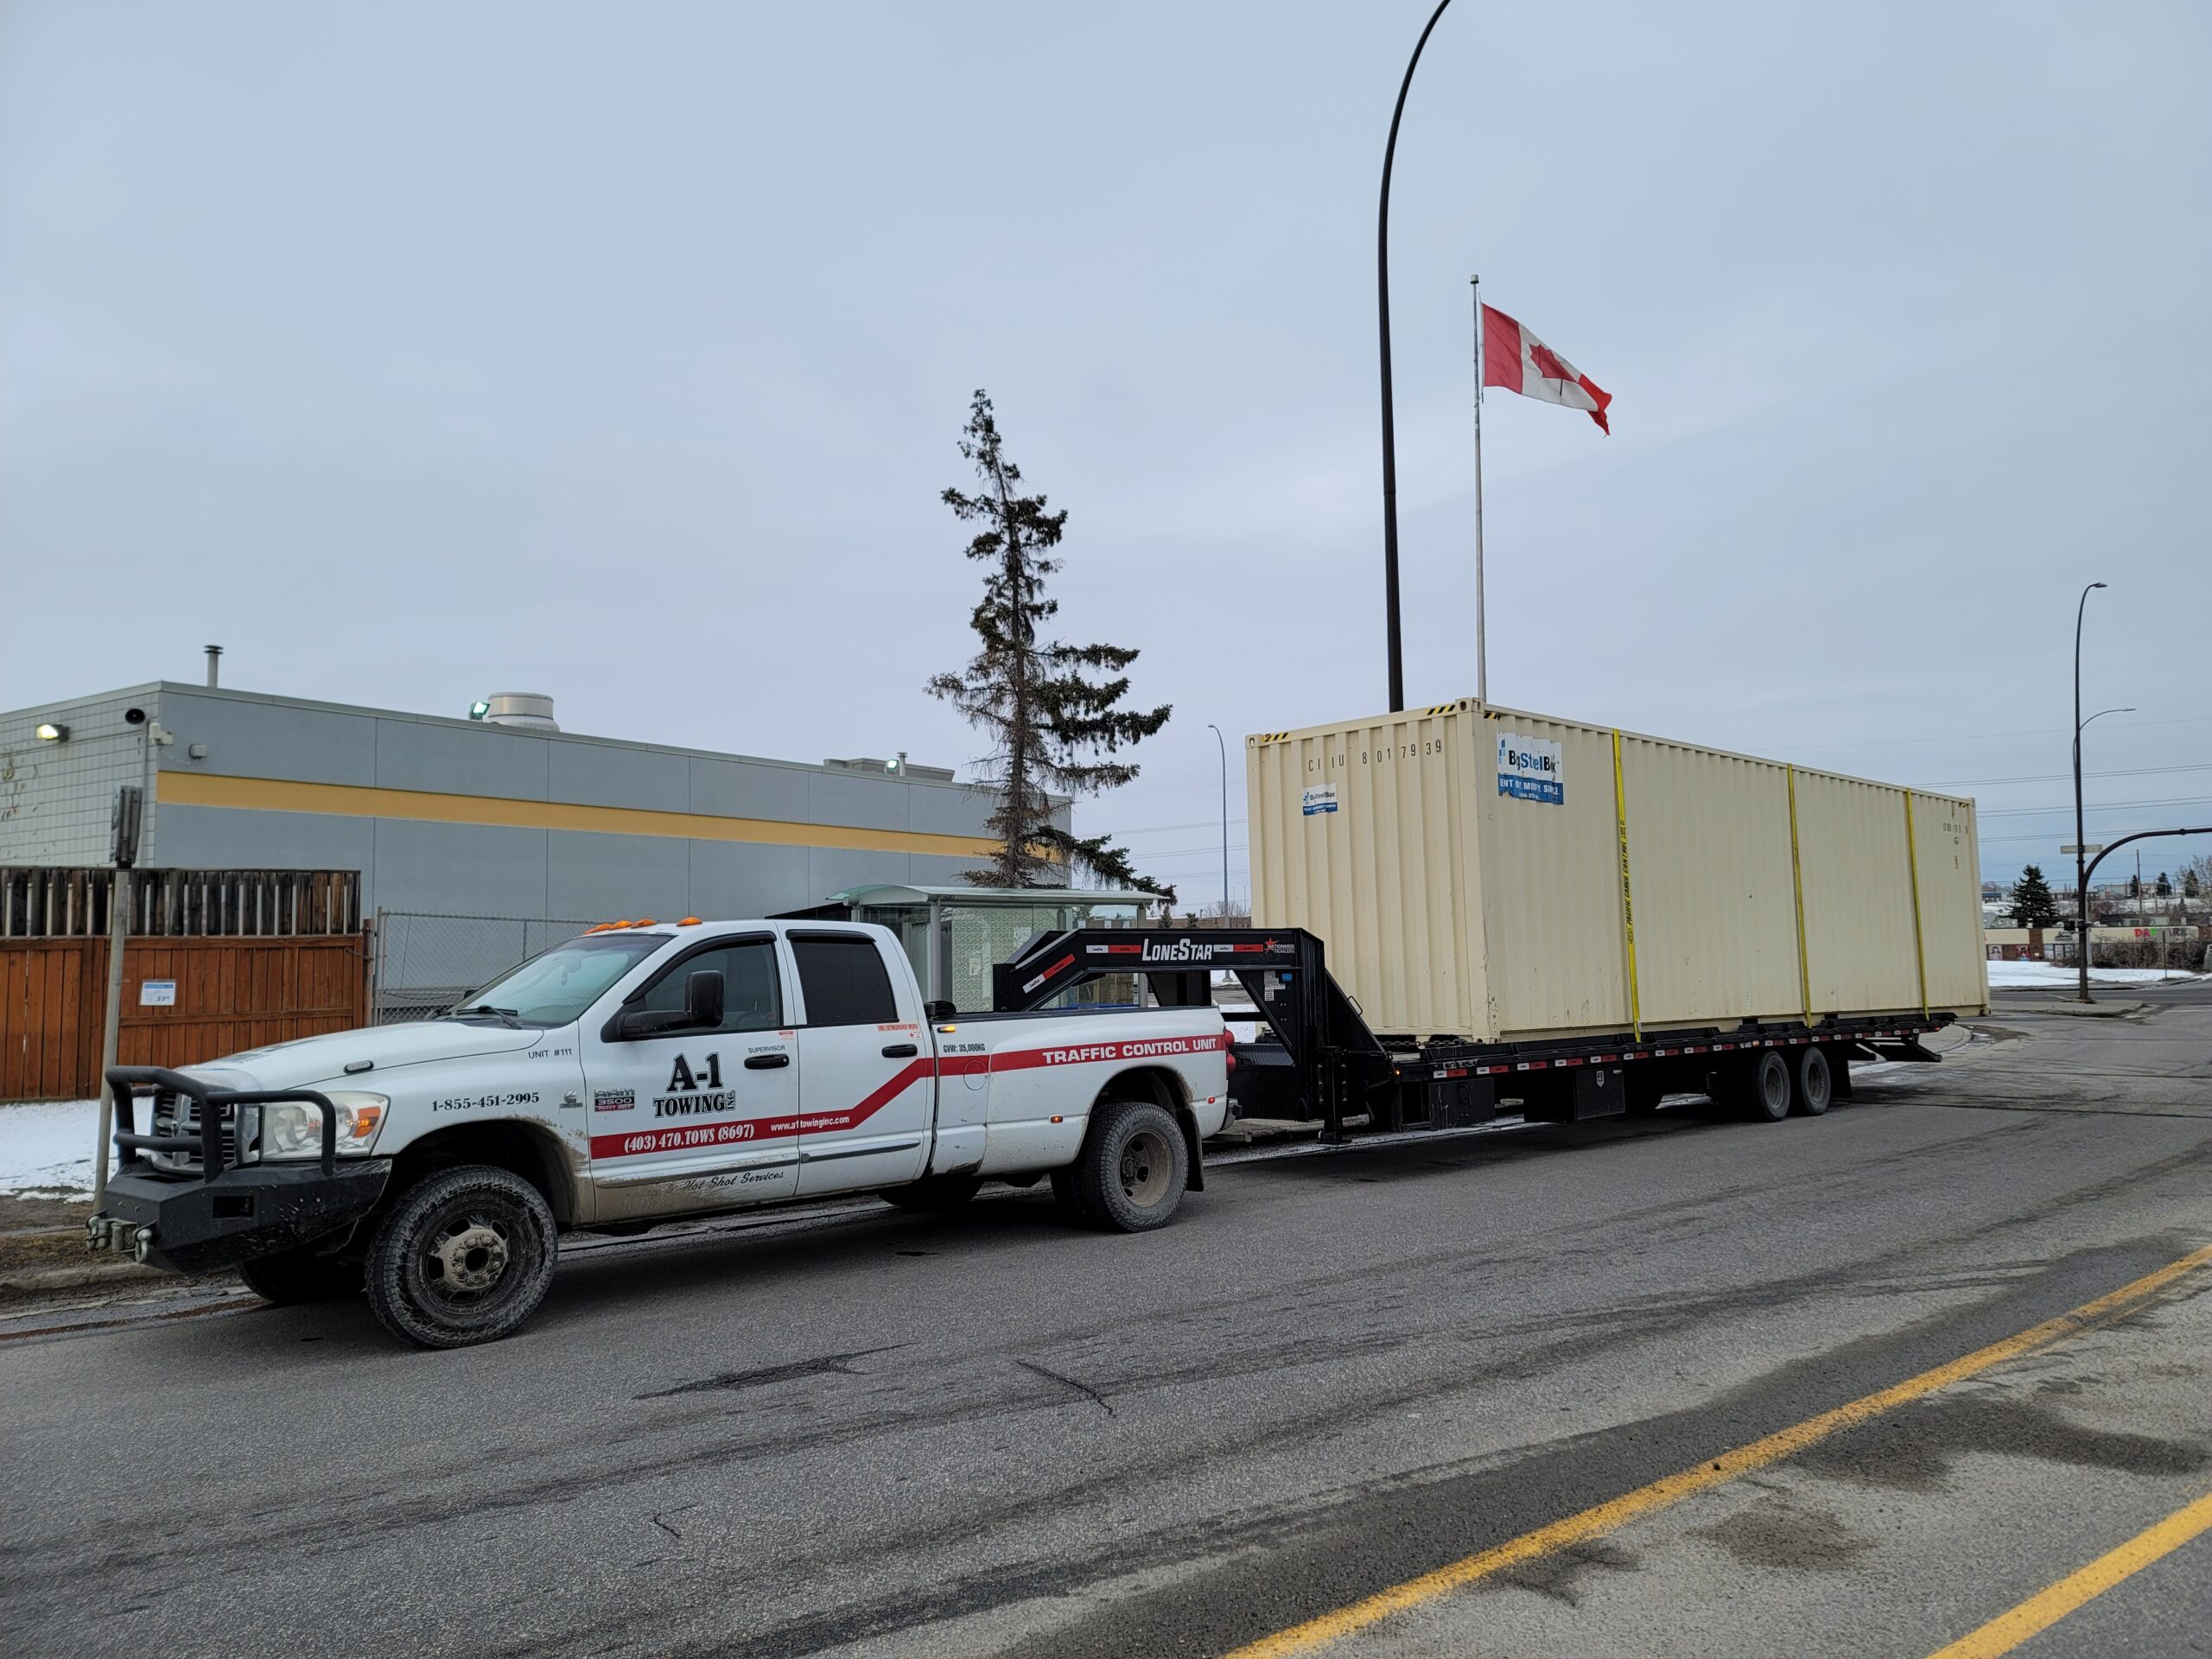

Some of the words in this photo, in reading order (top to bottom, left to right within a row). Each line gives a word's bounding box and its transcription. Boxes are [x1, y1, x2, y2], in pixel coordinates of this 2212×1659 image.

[1508, 749, 1556, 772] BgStelBx
[528, 1050, 550, 1058] UNIT
[747, 1045, 785, 1053] SUPERVISOR
[943, 1045, 958, 1053] GVW:
[958, 1043, 986, 1053] 35,000KG
[1042, 1046, 1116, 1065] TRAFFIC
[1122, 1040, 1189, 1057] CONTROL
[1192, 1039, 1217, 1050] UNIT
[665, 1052, 724, 1093] A-1
[431, 1091, 540, 1112] 1-855-451-2995
[652, 1092, 727, 1118] TOWING
[770, 1116, 850, 1132] www.a1towinginc.com
[624, 1136, 657, 1154] (403)
[658, 1128, 715, 1148] 470.TOWS
[718, 1123, 754, 1142] (8697)
[683, 1179, 704, 1193] Hot
[709, 1176, 736, 1189] Shot
[741, 1171, 784, 1184] Services
